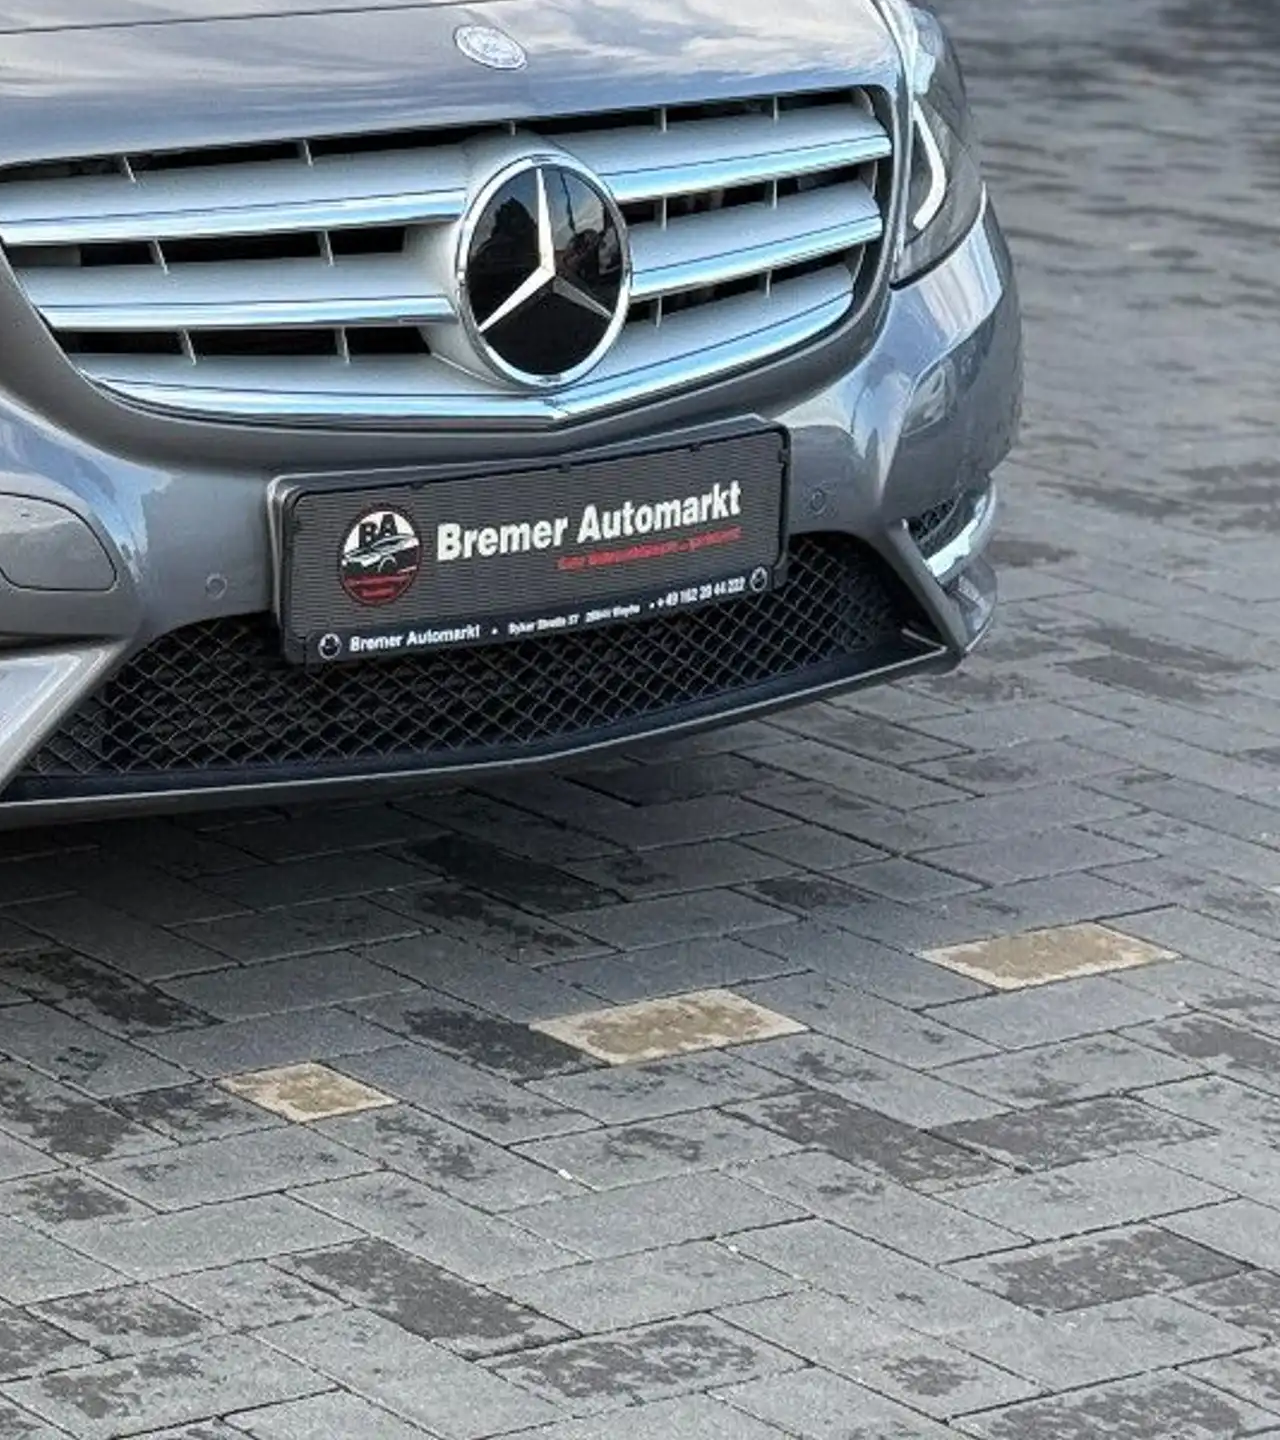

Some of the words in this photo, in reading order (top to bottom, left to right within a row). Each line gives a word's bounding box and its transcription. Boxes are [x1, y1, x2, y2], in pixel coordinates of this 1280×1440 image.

[437, 516, 569, 561] Bremer
[576, 479, 742, 544] Automarkt
[349, 633, 403, 652] Bremer
[406, 624, 481, 647] Automarkt
